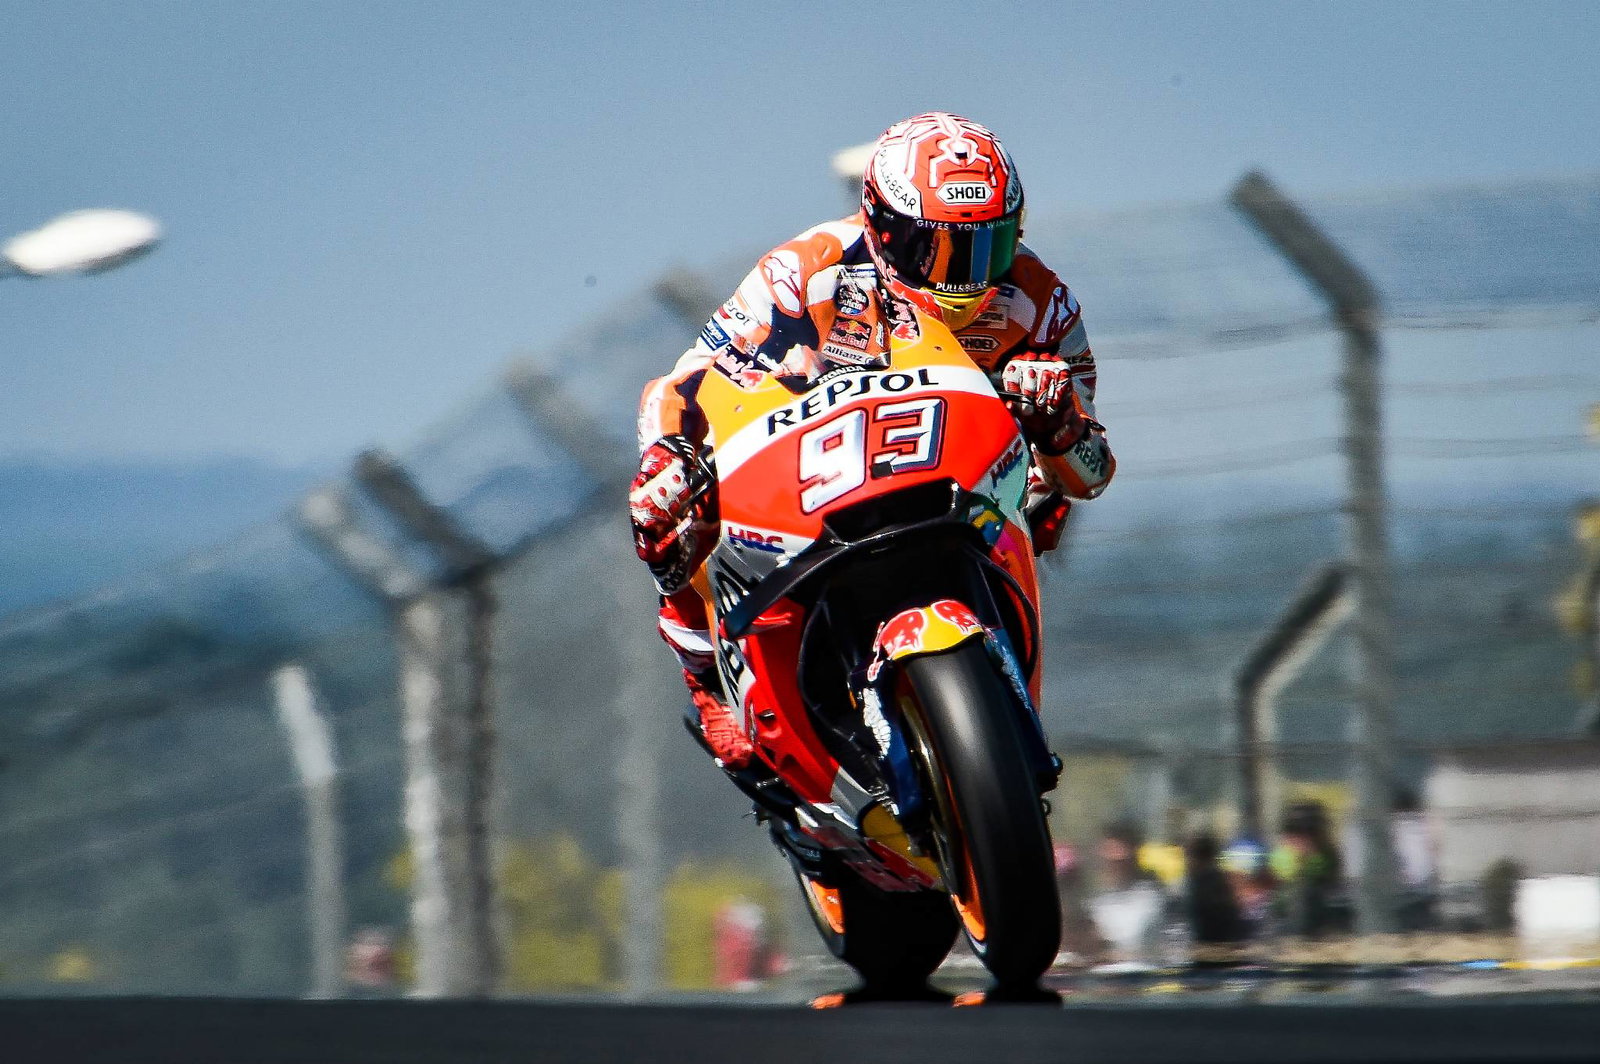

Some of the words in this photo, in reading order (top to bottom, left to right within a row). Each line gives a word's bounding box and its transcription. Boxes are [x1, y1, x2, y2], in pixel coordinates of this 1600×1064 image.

[946, 186, 986, 200] SHOEI
[916, 219, 949, 231] GIVES
[957, 223, 980, 231] YOU
[935, 281, 988, 293] PULL&BEAR
[823, 345, 863, 361] Allianz
[817, 365, 867, 384] HONDA
[767, 368, 940, 437] REPSOL
[799, 395, 948, 515] 93
